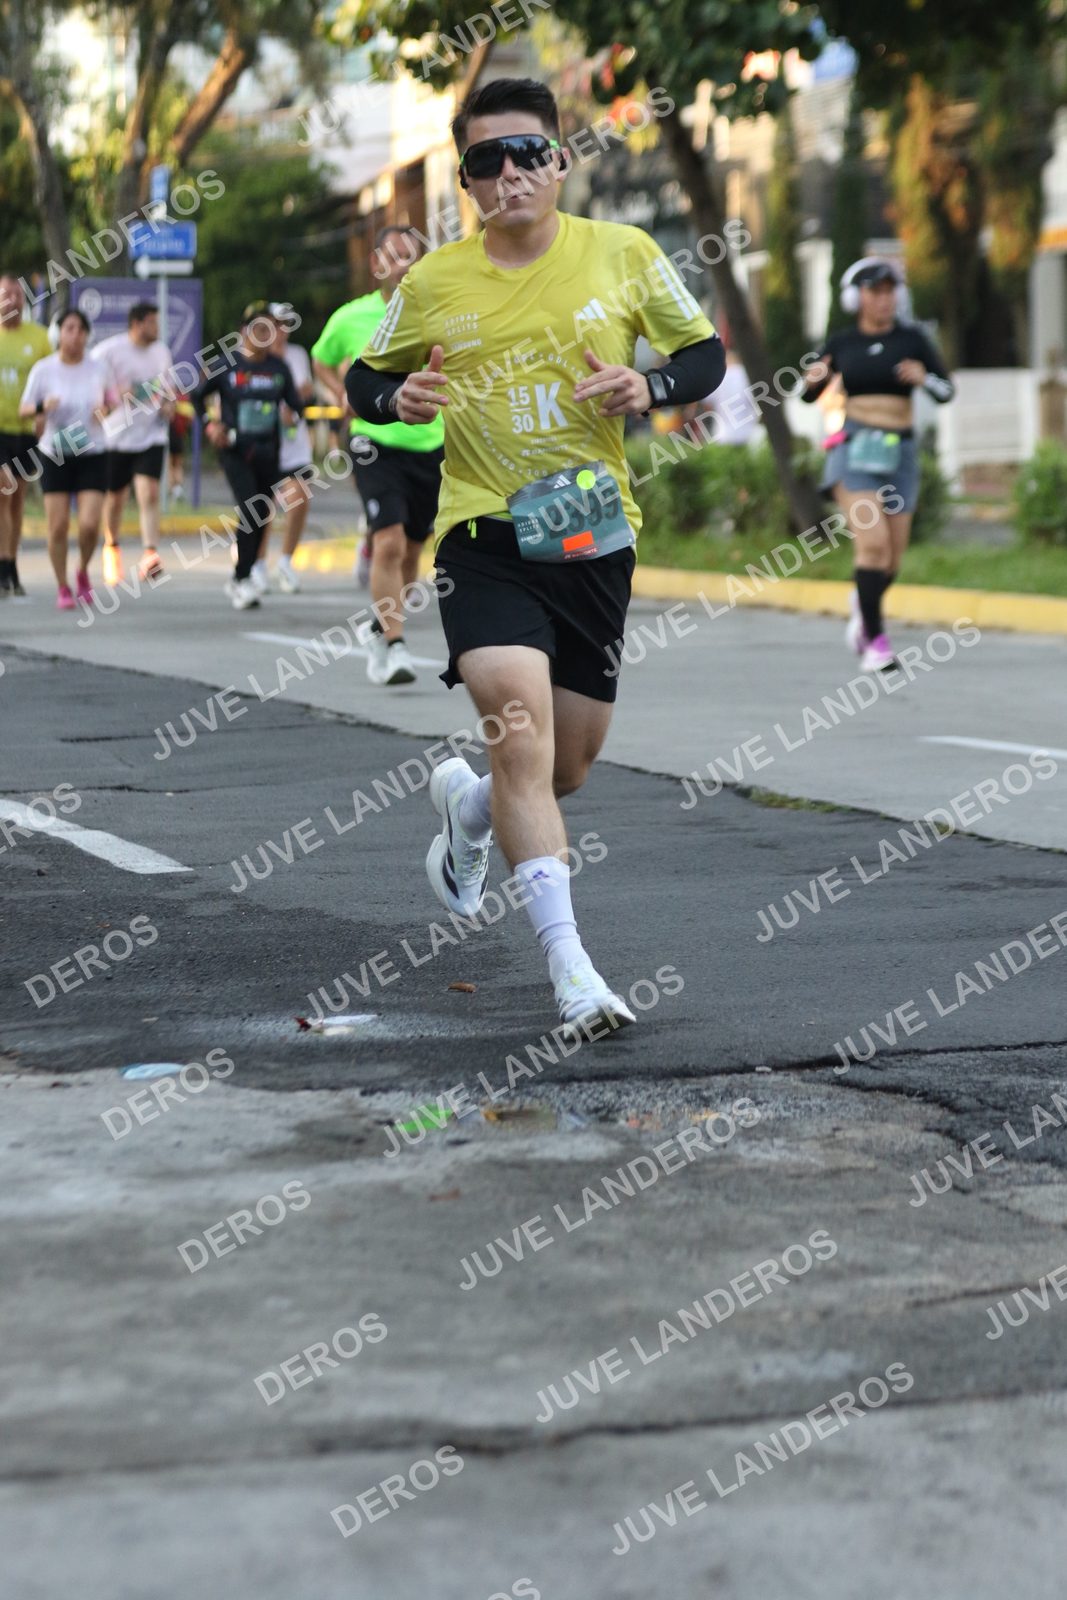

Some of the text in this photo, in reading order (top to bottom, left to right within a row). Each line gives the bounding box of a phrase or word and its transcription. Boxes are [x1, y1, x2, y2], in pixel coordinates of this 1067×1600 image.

[507, 385, 531, 407] 15
[534, 381, 569, 431] K
[511, 414, 535, 434] 30
